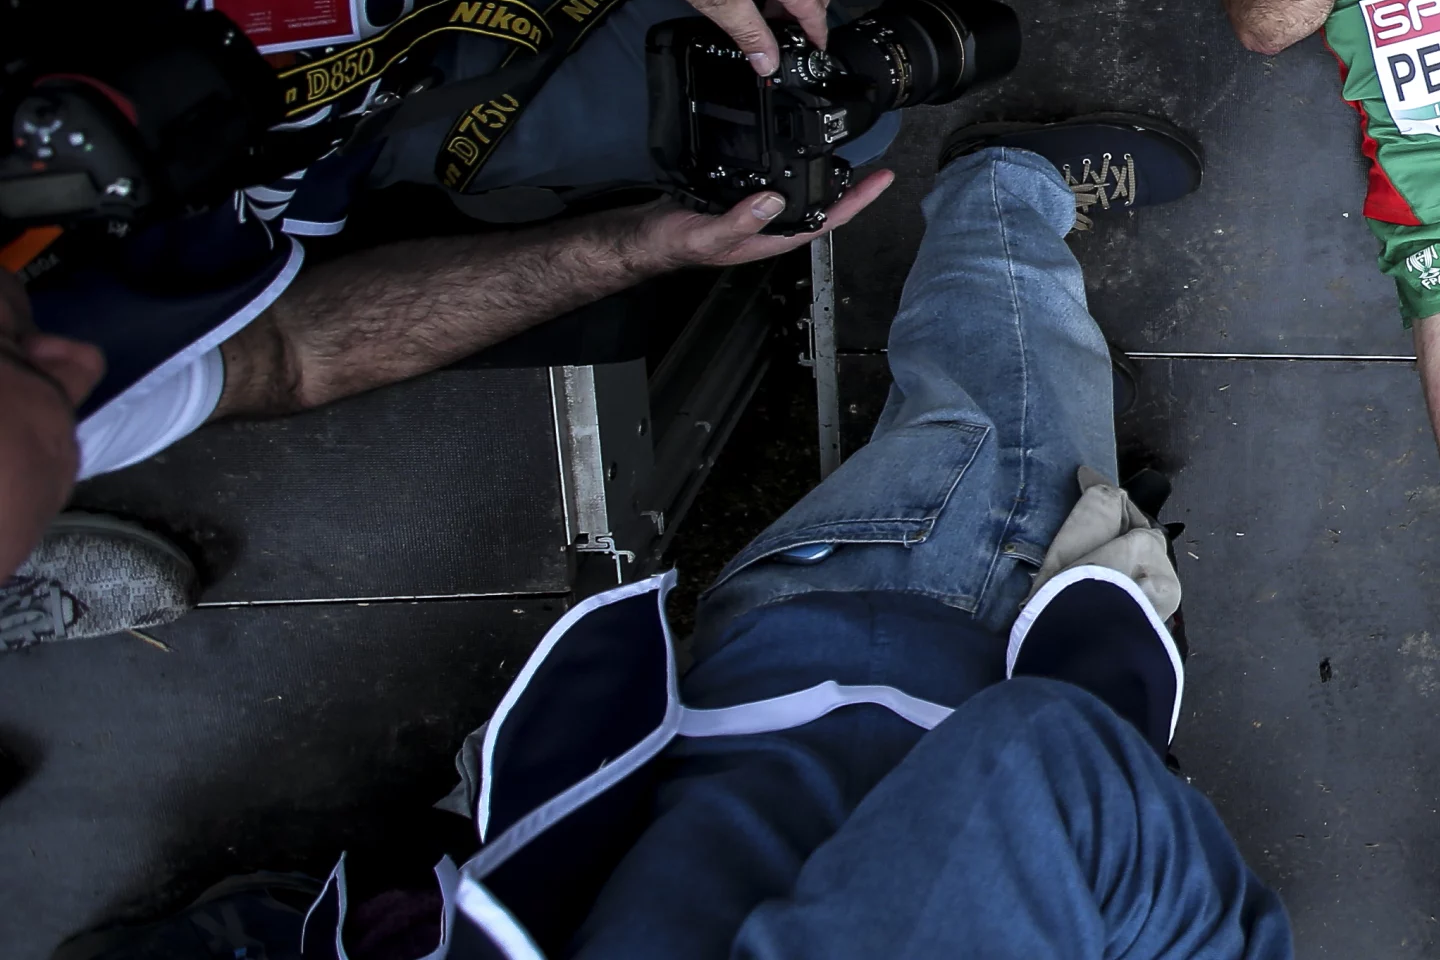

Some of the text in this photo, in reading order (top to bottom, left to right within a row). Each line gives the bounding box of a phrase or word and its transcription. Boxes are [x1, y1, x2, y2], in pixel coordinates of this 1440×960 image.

[448, 1, 542, 44] Nikon
[306, 48, 374, 100] D850
[447, 93, 519, 166] D750
[1434, 103, 1440, 116] I
